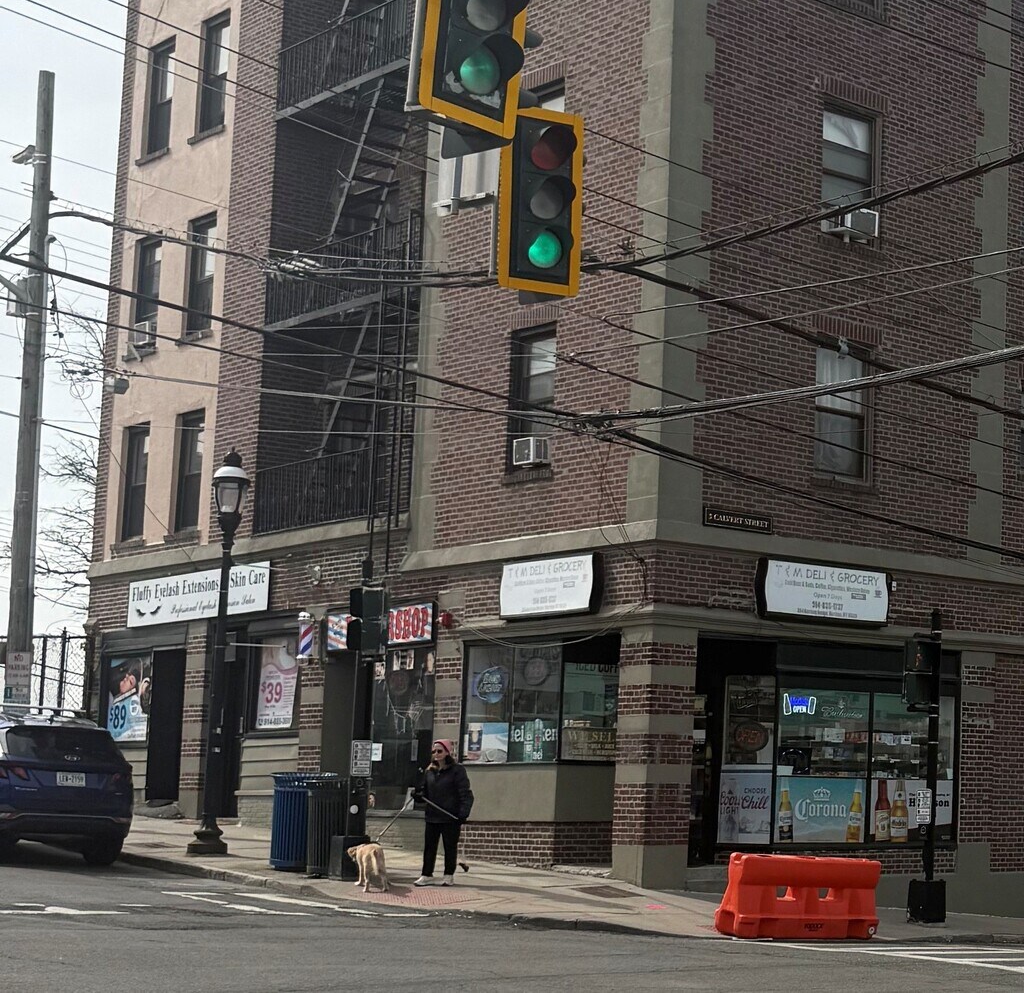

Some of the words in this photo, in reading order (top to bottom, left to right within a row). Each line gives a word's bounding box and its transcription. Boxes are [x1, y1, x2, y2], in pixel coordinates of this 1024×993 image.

[713, 514, 744, 524] CALVERT
[744, 518, 769, 528] STREET
[520, 567, 528, 577] M
[529, 565, 545, 575] DELI
[553, 560, 587, 574] GROCERY
[775, 564, 782, 575] T
[793, 567, 802, 578] M
[806, 569, 826, 580] DELI
[838, 572, 880, 586] GROCERY
[131, 586, 152, 603] Fluffy
[154, 581, 179, 601] Eyelash
[182, 577, 219, 595] Extensions
[230, 572, 246, 588] Skin
[248, 570, 266, 586] Care
[261, 681, 283, 704] $39
[110, 705, 127, 730] $89
[741, 796, 769, 809] Chill
[795, 799, 847, 822] Corona
